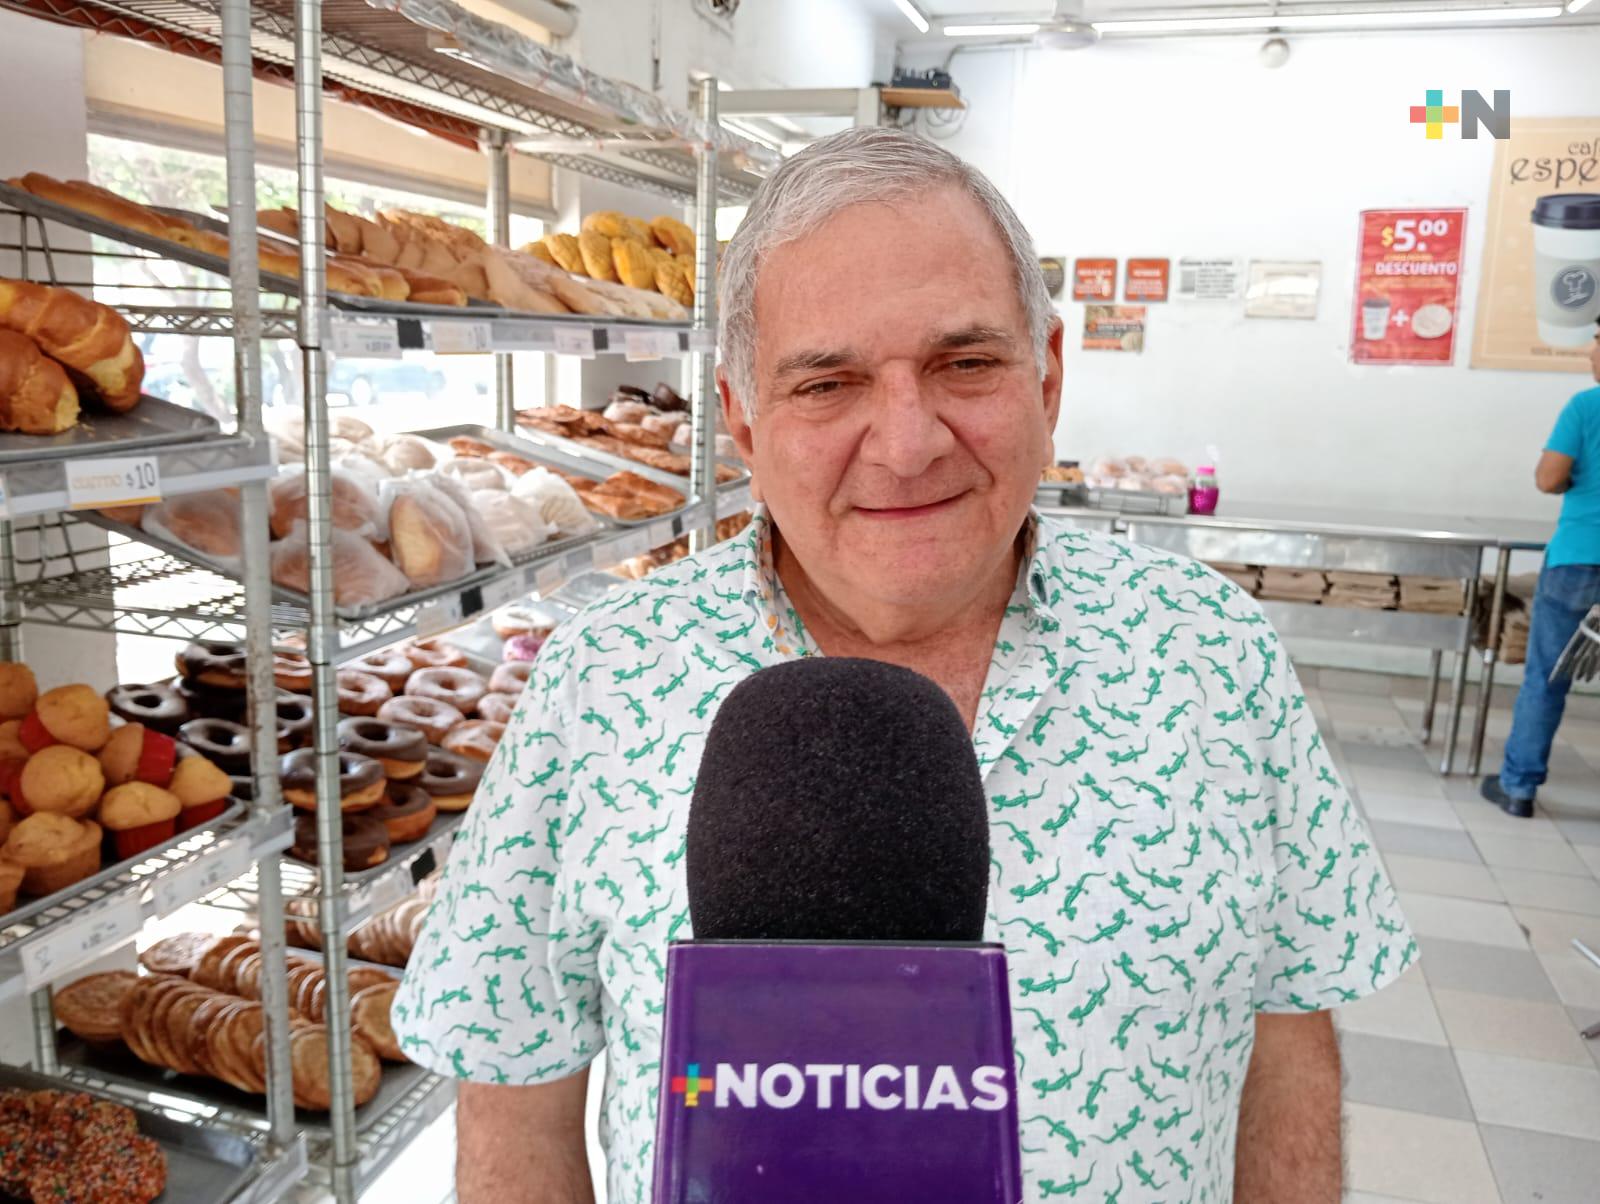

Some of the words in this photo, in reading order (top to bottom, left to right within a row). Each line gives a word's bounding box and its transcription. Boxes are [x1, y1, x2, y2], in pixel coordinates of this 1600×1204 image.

[1510, 157, 1600, 189] espe
[1375, 262, 1457, 275] DESCUENTO
[126, 462, 156, 490] $10
